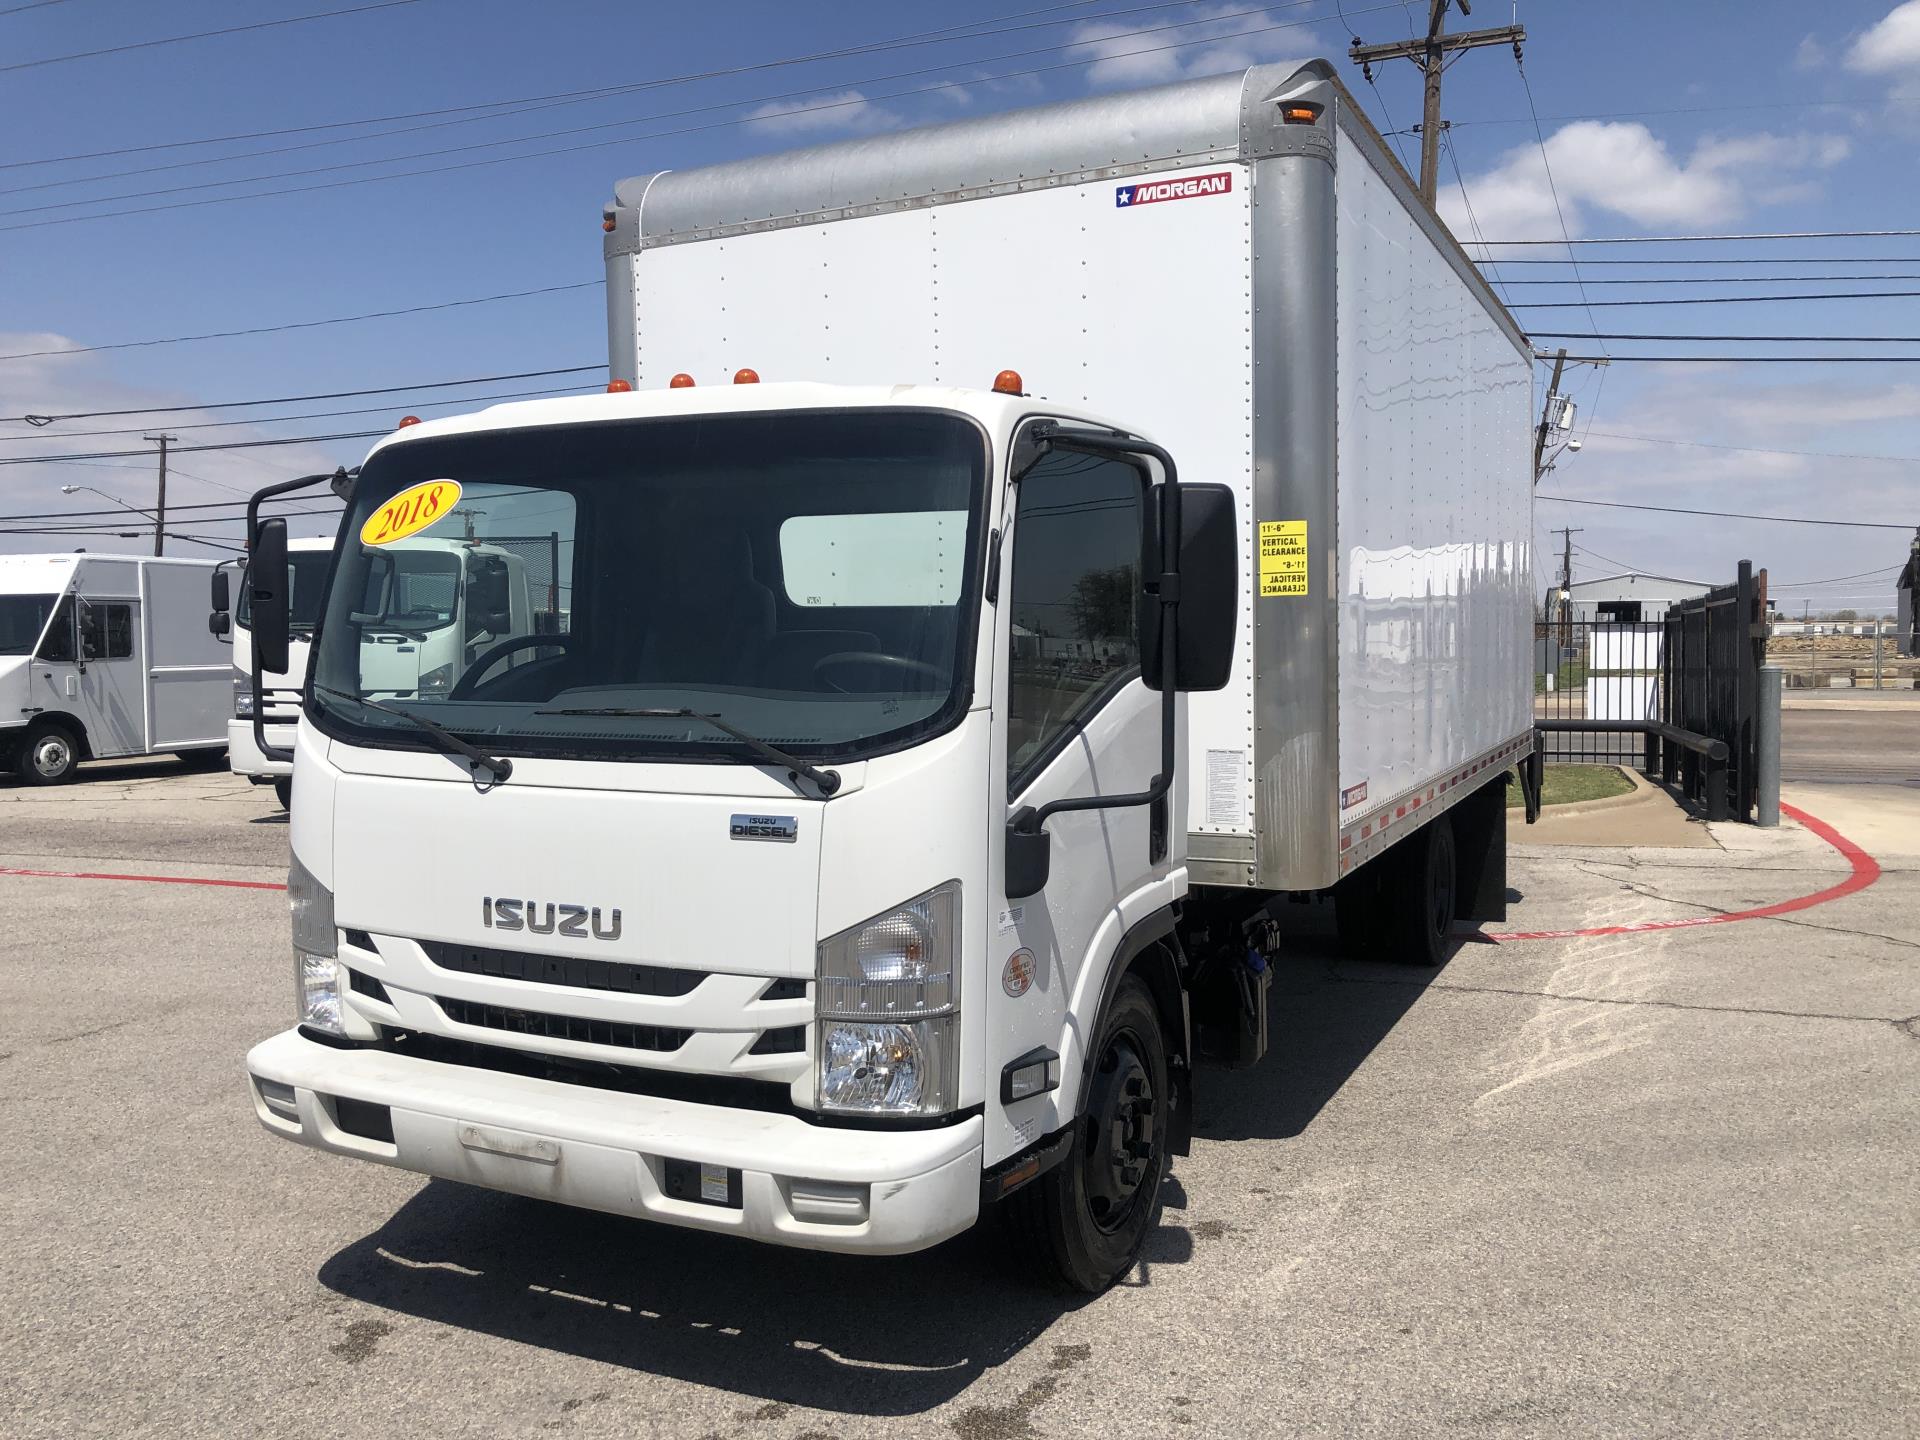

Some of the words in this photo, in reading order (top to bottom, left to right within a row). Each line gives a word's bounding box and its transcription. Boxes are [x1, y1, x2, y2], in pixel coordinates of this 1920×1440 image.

[1135, 176, 1226, 203] MORGAN
[374, 485, 444, 540] 2018
[1262, 538, 1298, 546] VERTICAL
[1262, 547, 1306, 557] CLEARANCE
[749, 817, 777, 825] ISUZU
[732, 825, 793, 838] DIESEL
[483, 896, 622, 941] ISUZU
